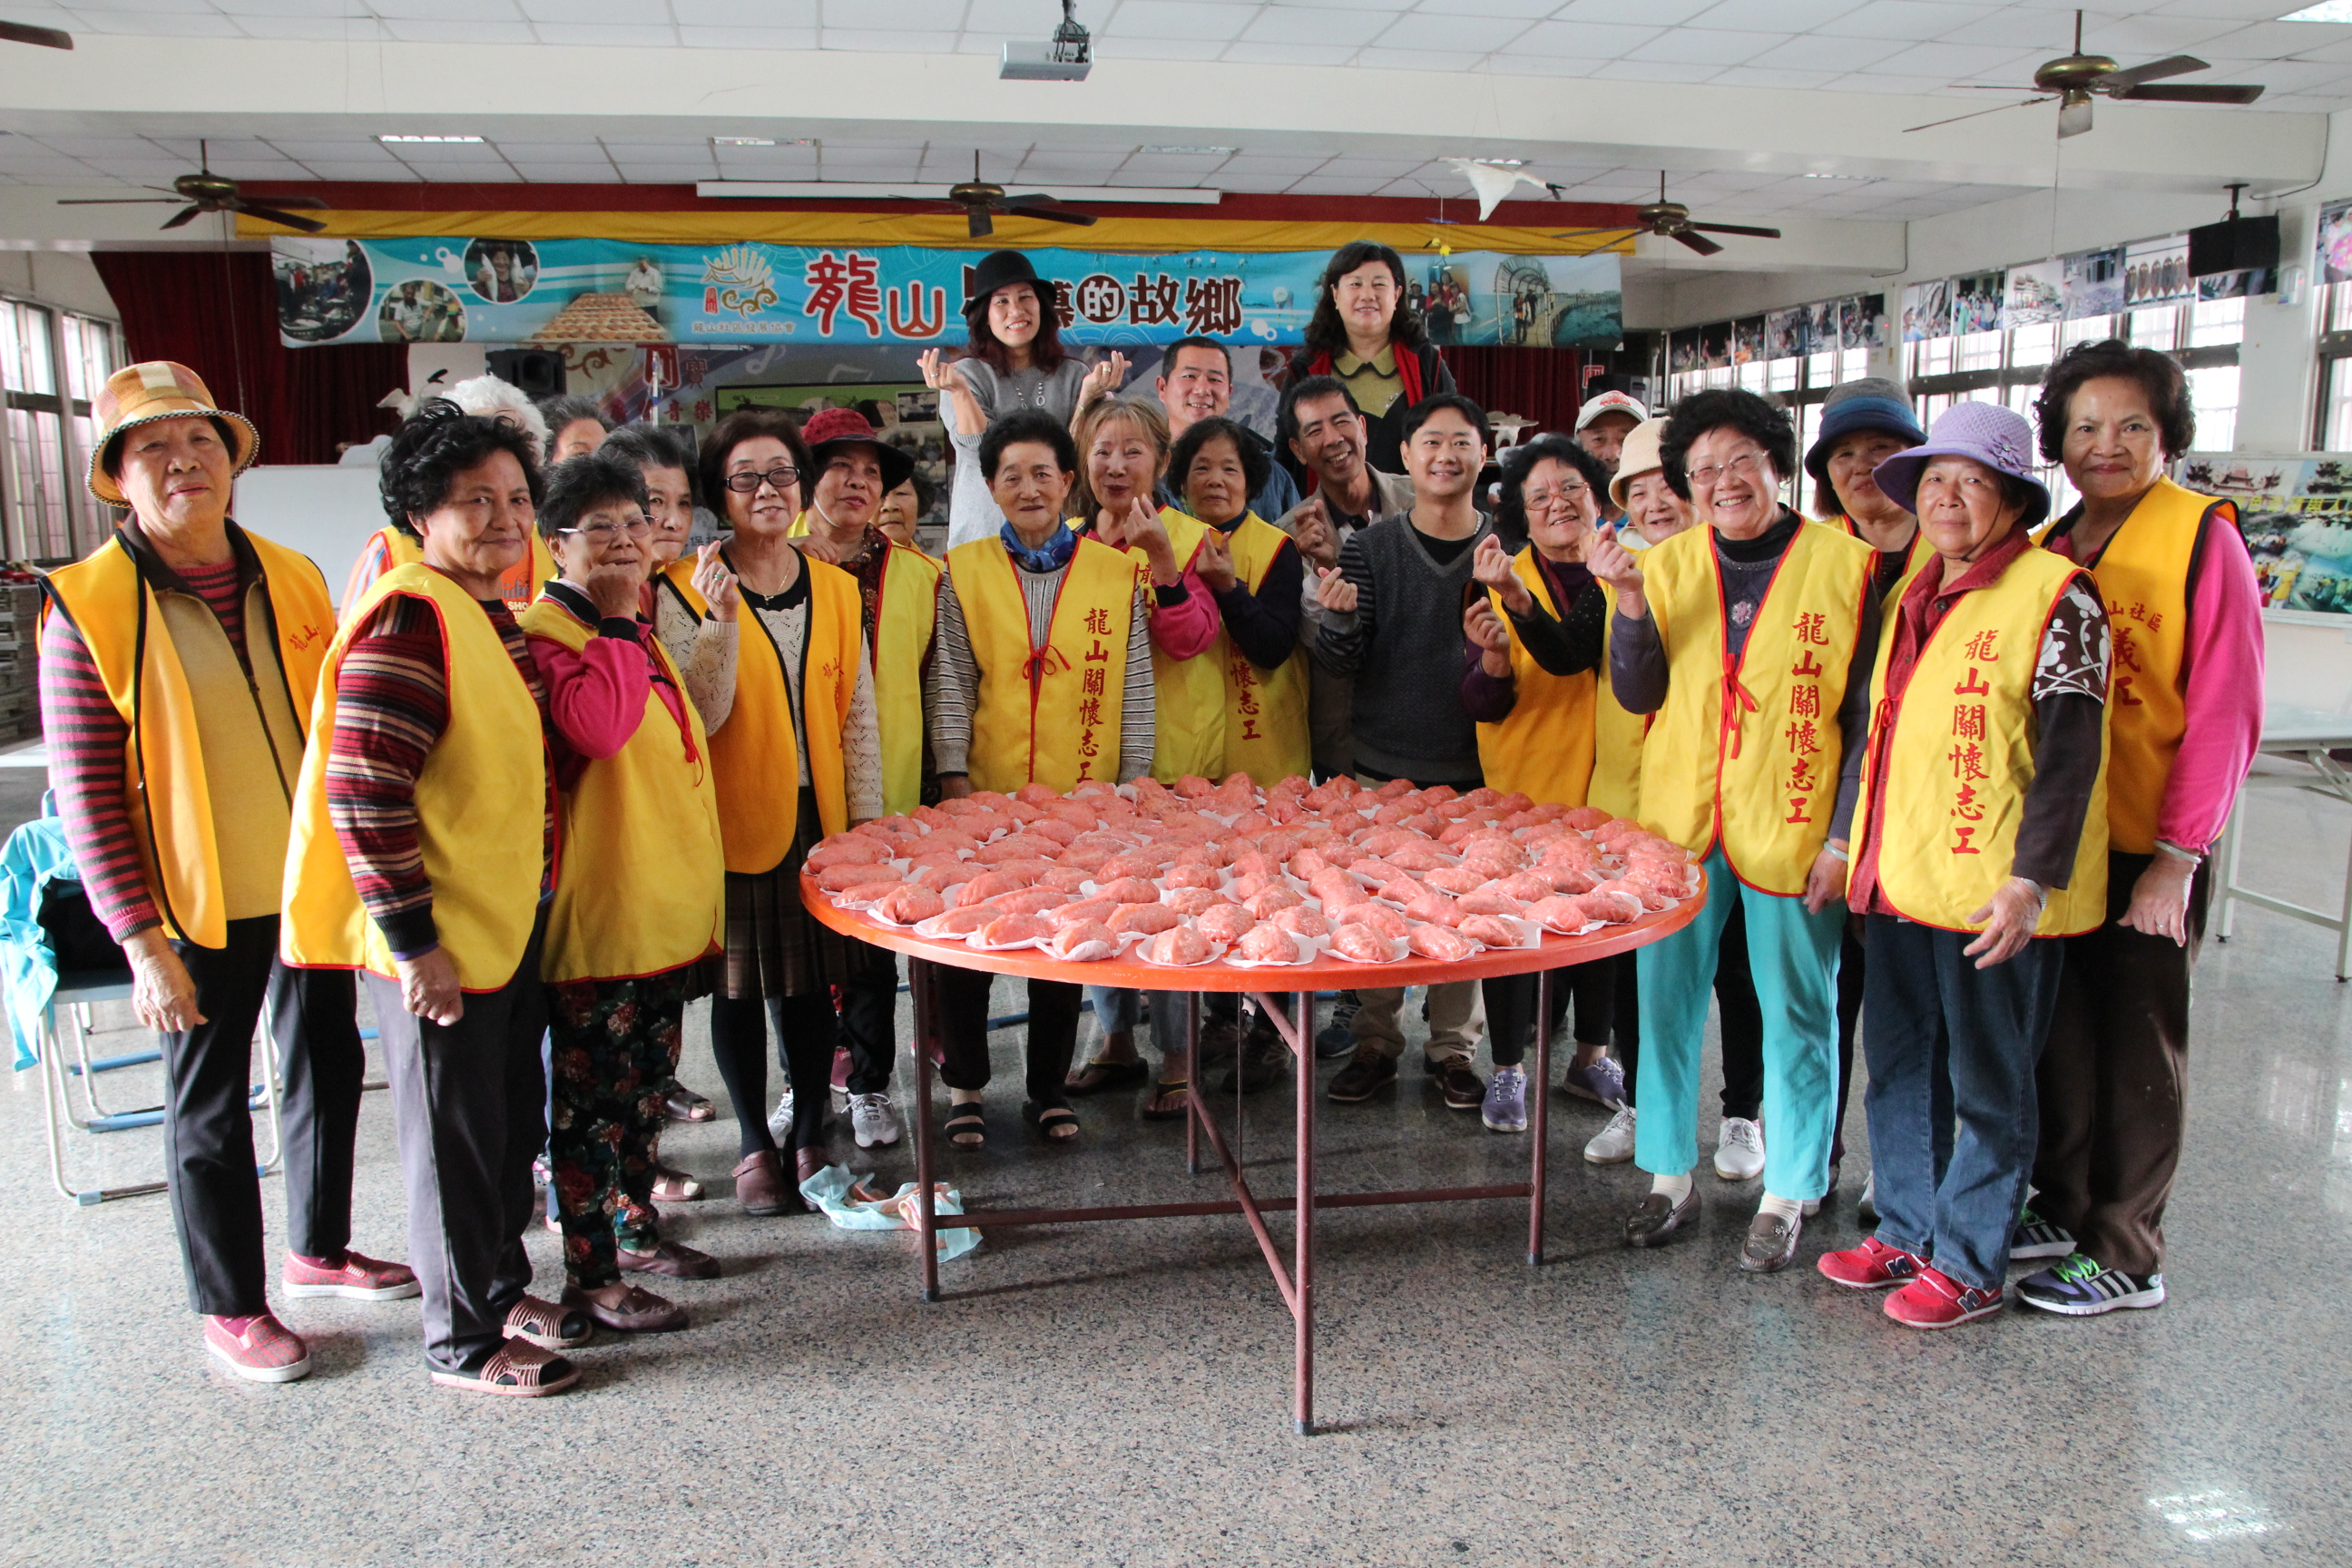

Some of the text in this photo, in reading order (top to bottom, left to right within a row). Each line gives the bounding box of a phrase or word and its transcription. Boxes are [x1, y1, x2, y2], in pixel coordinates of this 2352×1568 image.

[805, 252, 1242, 337] 龍山的故鄉
[1076, 607, 1112, 783] 龍山關懷志工
[1785, 612, 1829, 825] 龍山關懷志工
[1948, 629, 1999, 856] 龍山關懷志工
